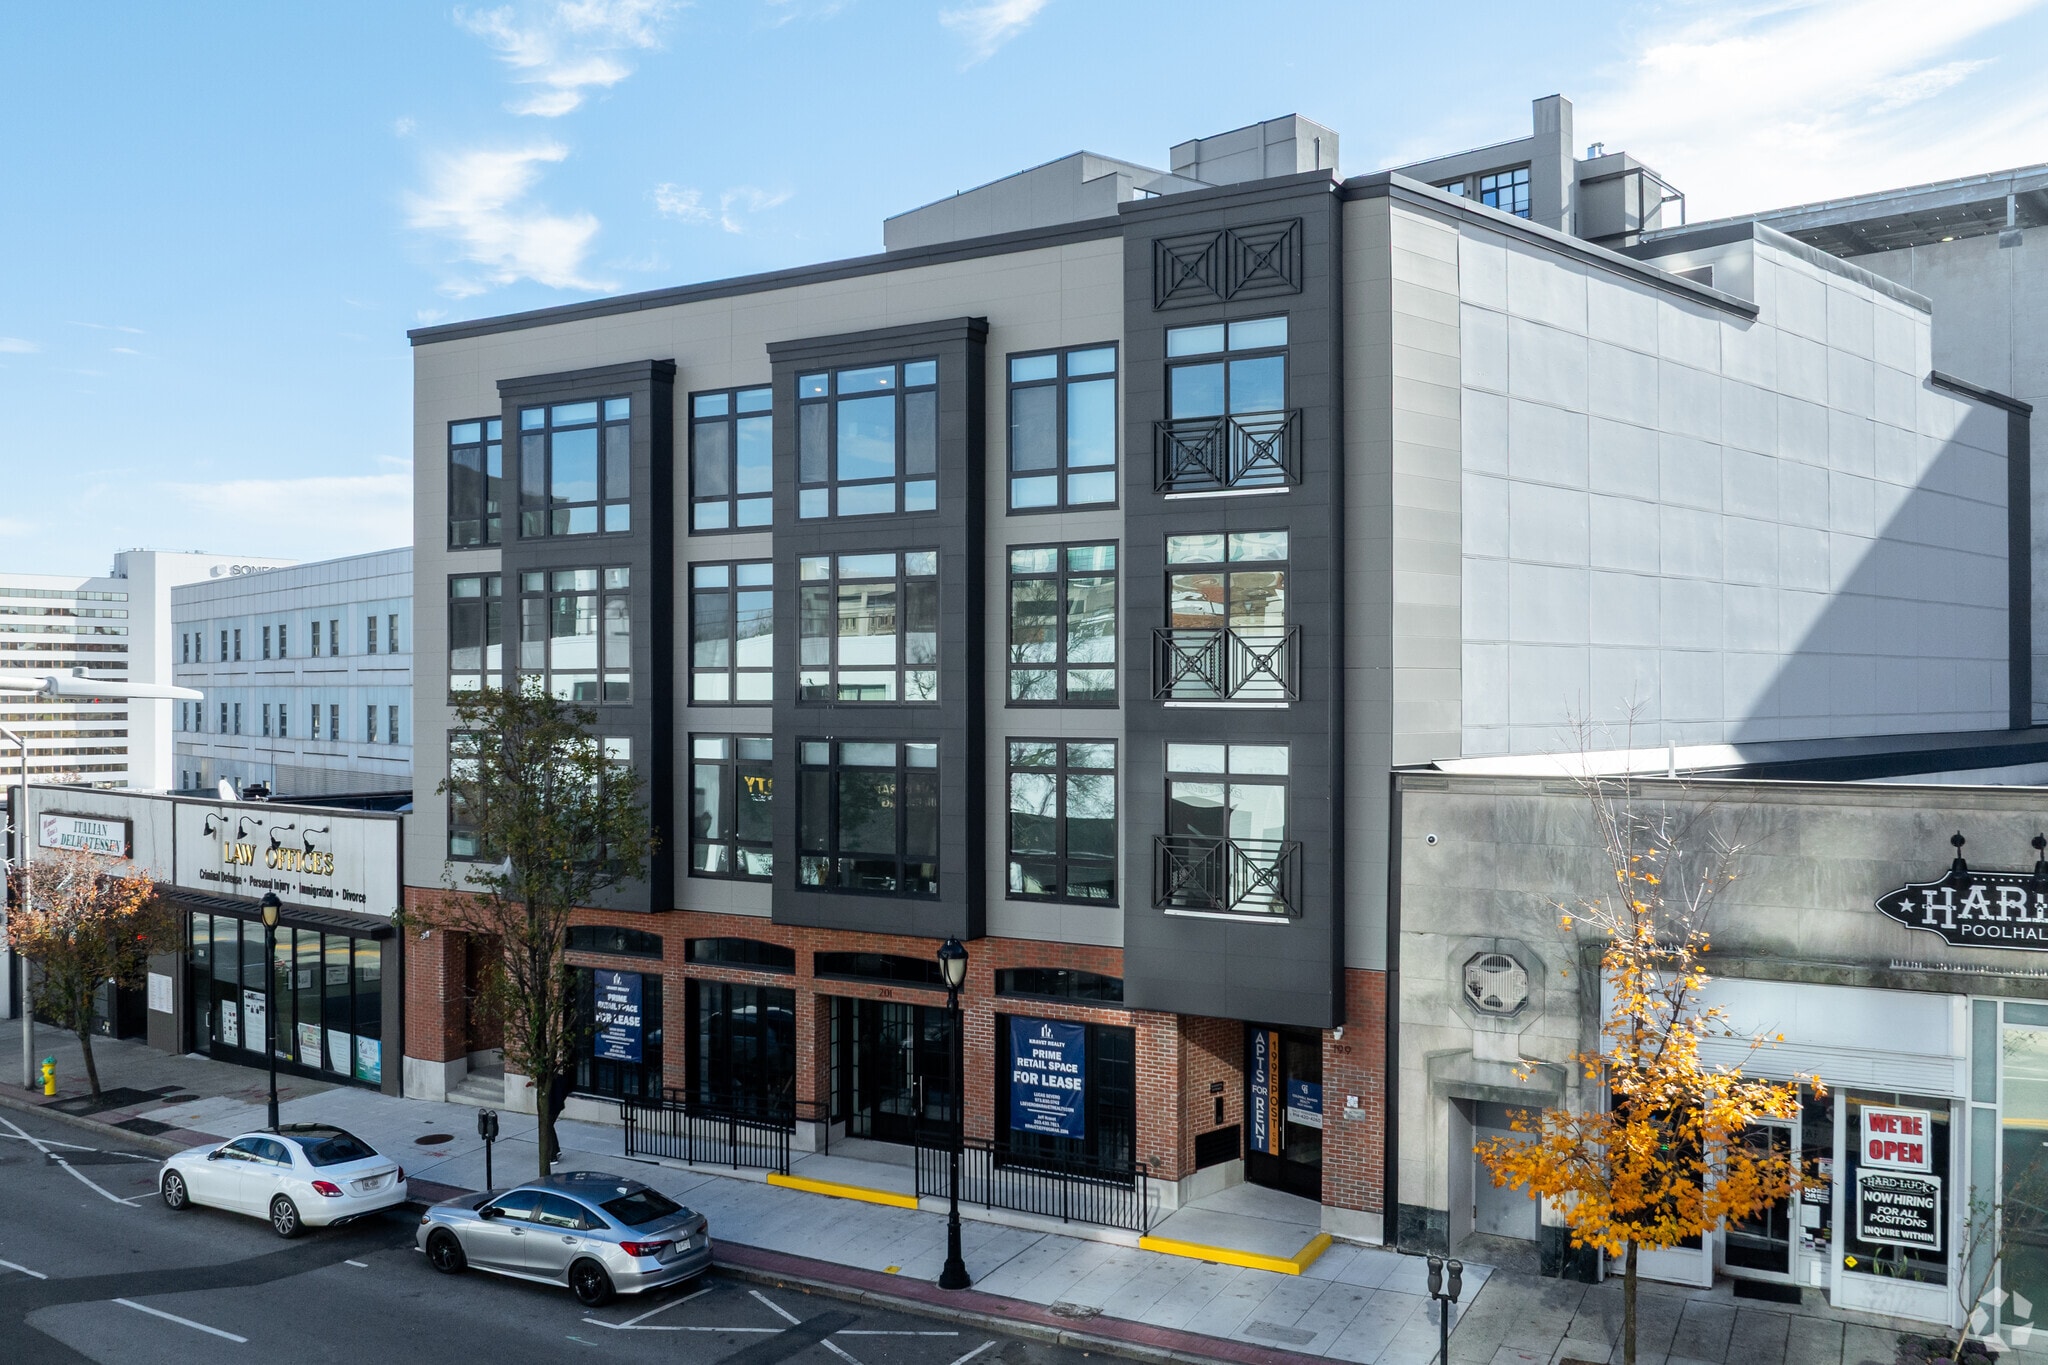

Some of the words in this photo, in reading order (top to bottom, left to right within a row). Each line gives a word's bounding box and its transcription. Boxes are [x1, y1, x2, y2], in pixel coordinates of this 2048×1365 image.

[73, 820, 108, 837] ITALIAN
[60, 833, 122, 853] DELICATESSEN
[224, 841, 257, 867] LAW
[265, 846, 334, 876] OFFICES
[199, 868, 221, 883] Criminal
[221, 871, 242, 885] Defense
[249, 875, 272, 889] Personal
[273, 878, 290, 894] Injury
[299, 882, 333, 899] Immigration
[342, 888, 366, 904] Divorce
[1961, 924, 2048, 941] POOLHAL
[607, 993, 628, 1003] PRIME
[878, 987, 893, 998] 201
[613, 1014, 641, 1027] LEASE
[1028, 1038, 1047, 1046] KRAVET
[1333, 1044, 1352, 1055] 199
[1032, 1048, 1062, 1061] PRIME
[1255, 1032, 1265, 1083] APTS
[1017, 1057, 1047, 1070] RETAIL
[1048, 1061, 1078, 1074] SPACE
[1013, 1070, 1039, 1085] FOR
[1041, 1074, 1082, 1091] LEASE
[1252, 1084, 1268, 1096] FOR
[1255, 1097, 1265, 1149] RENT
[1868, 1112, 1923, 1136] WE'RE
[1868, 1139, 1923, 1164] OPEN
[1864, 1190, 1893, 1203] NOW
[1893, 1194, 1934, 1209] HIRING
[1870, 1213, 1928, 1228] POSITIONS
[1877, 1206, 1899, 1216] FOR
[1900, 1208, 1920, 1219] ALL
[1864, 1225, 1900, 1238] INQUIRE
[1901, 1229, 1934, 1242] WITHIN
